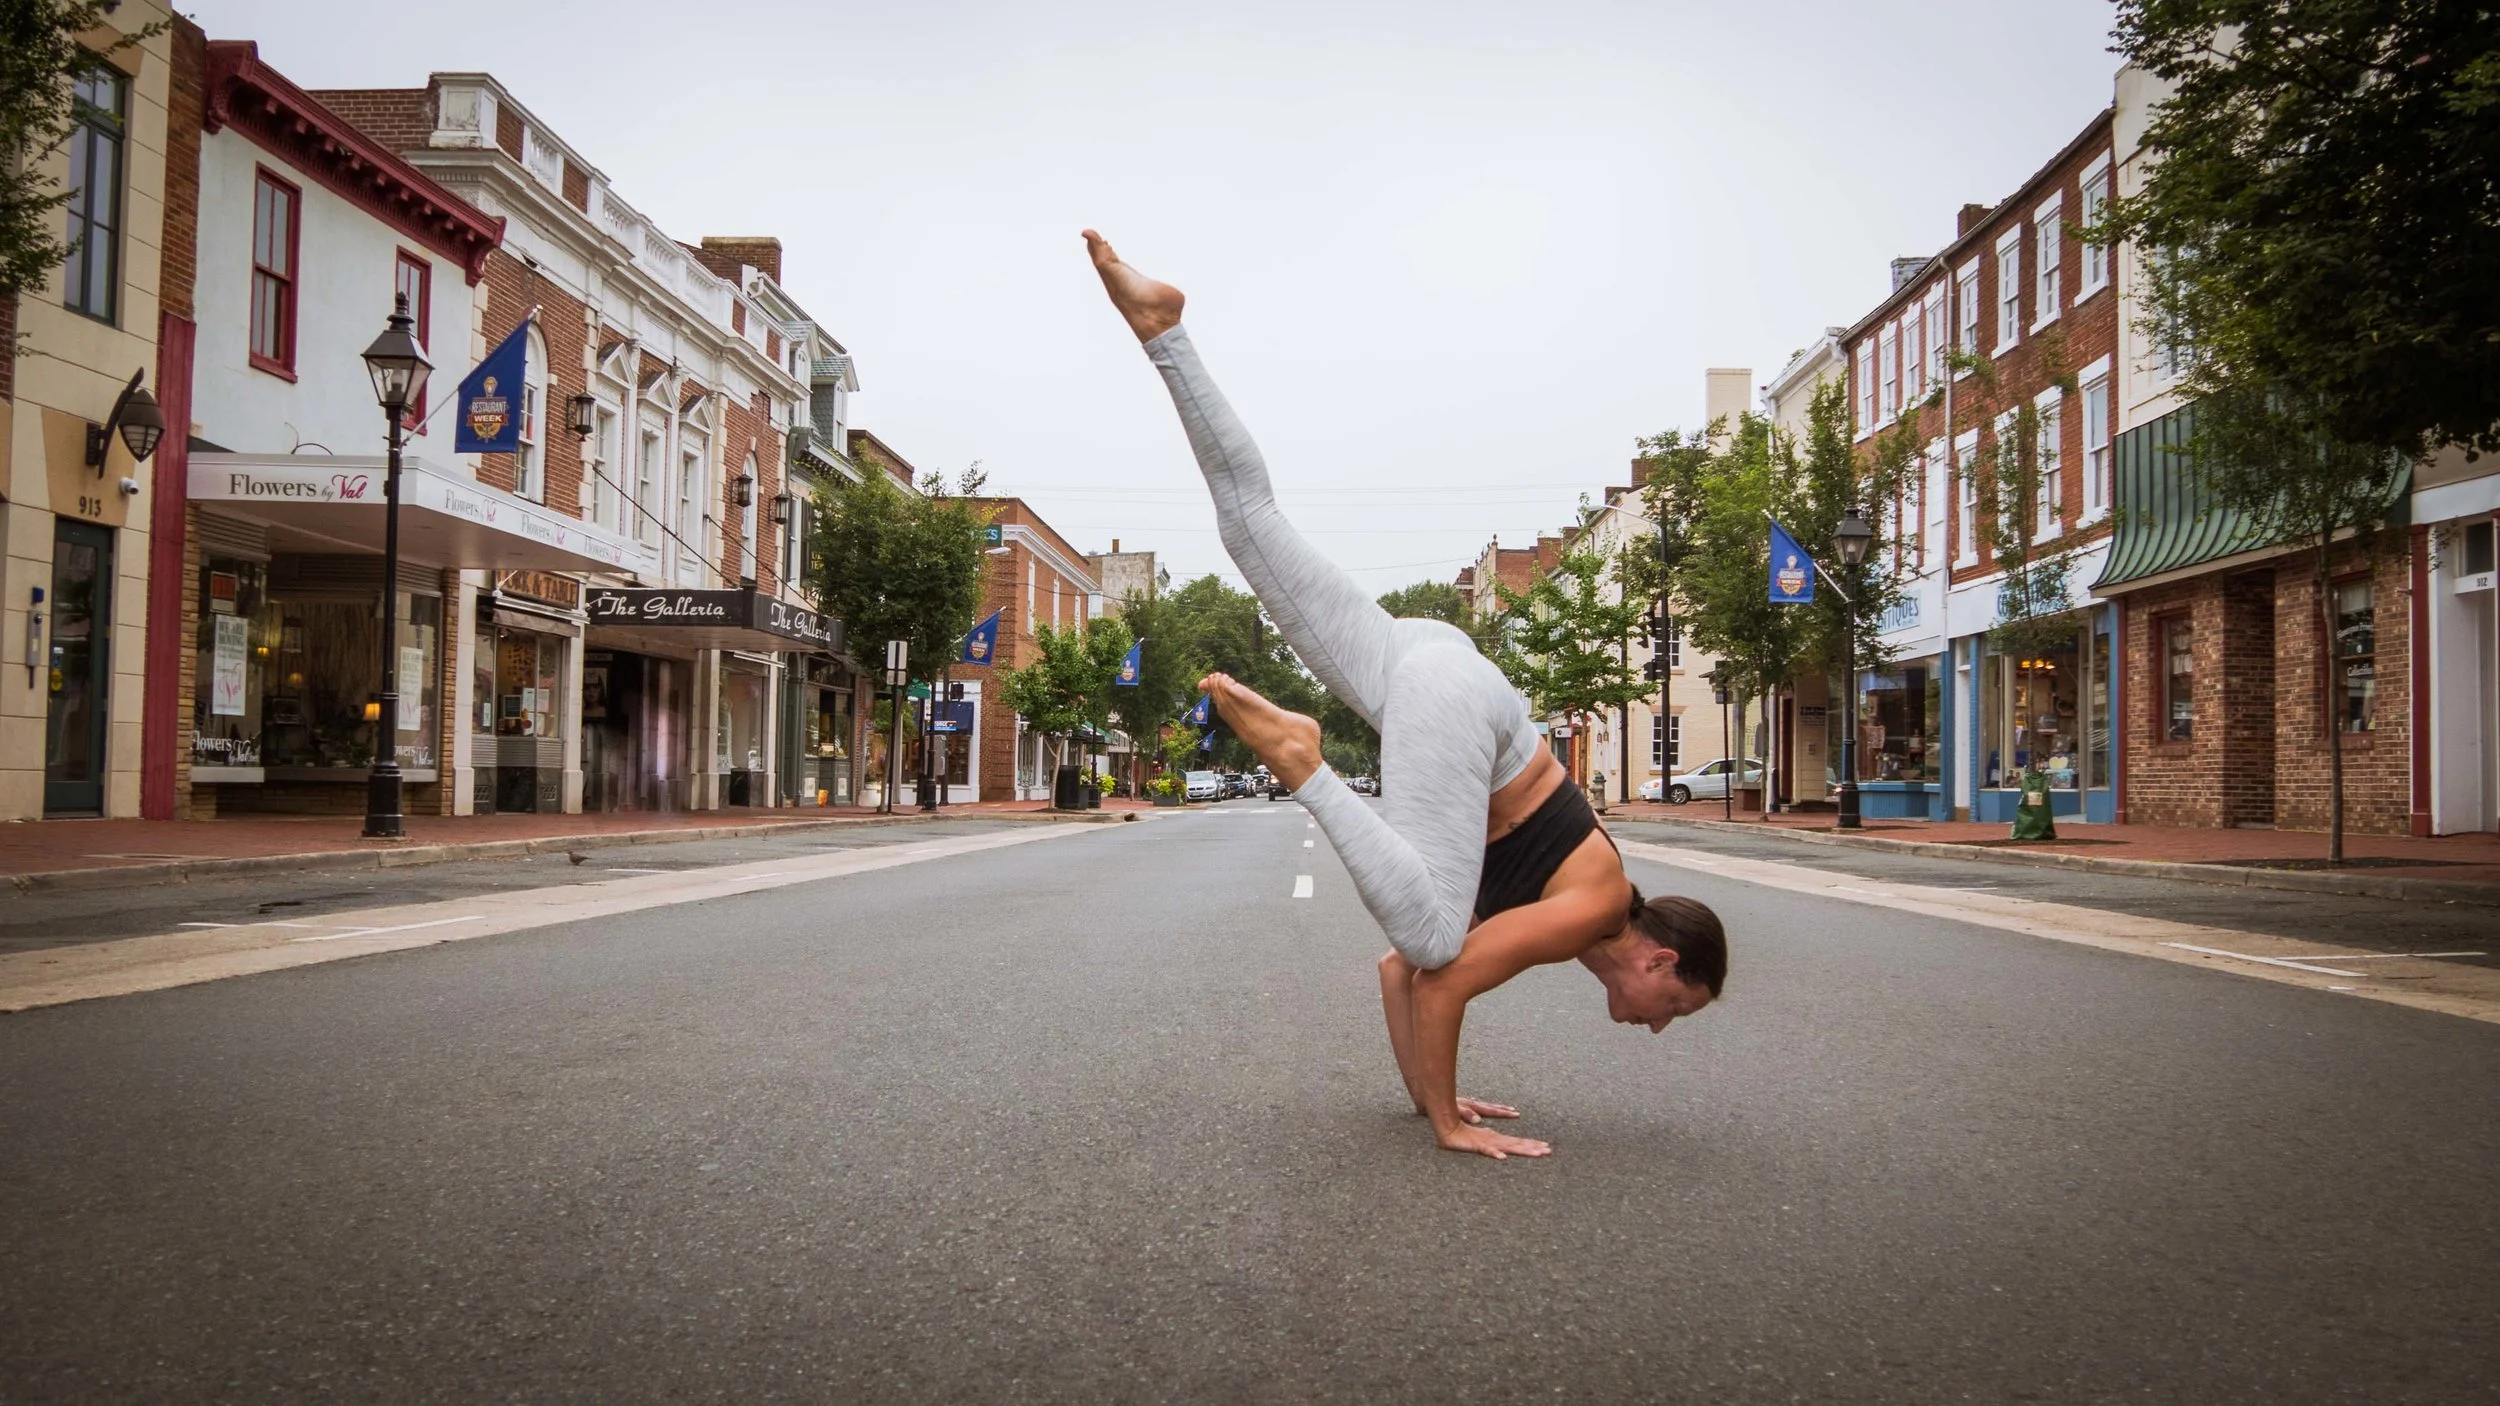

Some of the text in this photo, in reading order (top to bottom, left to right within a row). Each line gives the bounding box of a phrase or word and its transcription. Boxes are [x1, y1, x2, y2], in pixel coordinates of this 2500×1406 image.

[471, 401, 507, 413] RESTAURANT
[229, 473, 368, 501] Flowers by Val
[79, 495, 102, 518] 913
[445, 489, 480, 516] Flowers
[533, 574, 542, 595] &
[545, 576, 577, 604] TABLE
[598, 596, 725, 619] The Galleria
[1878, 598, 1919, 631] NTIQUES
[770, 602, 831, 642] The Galleria
